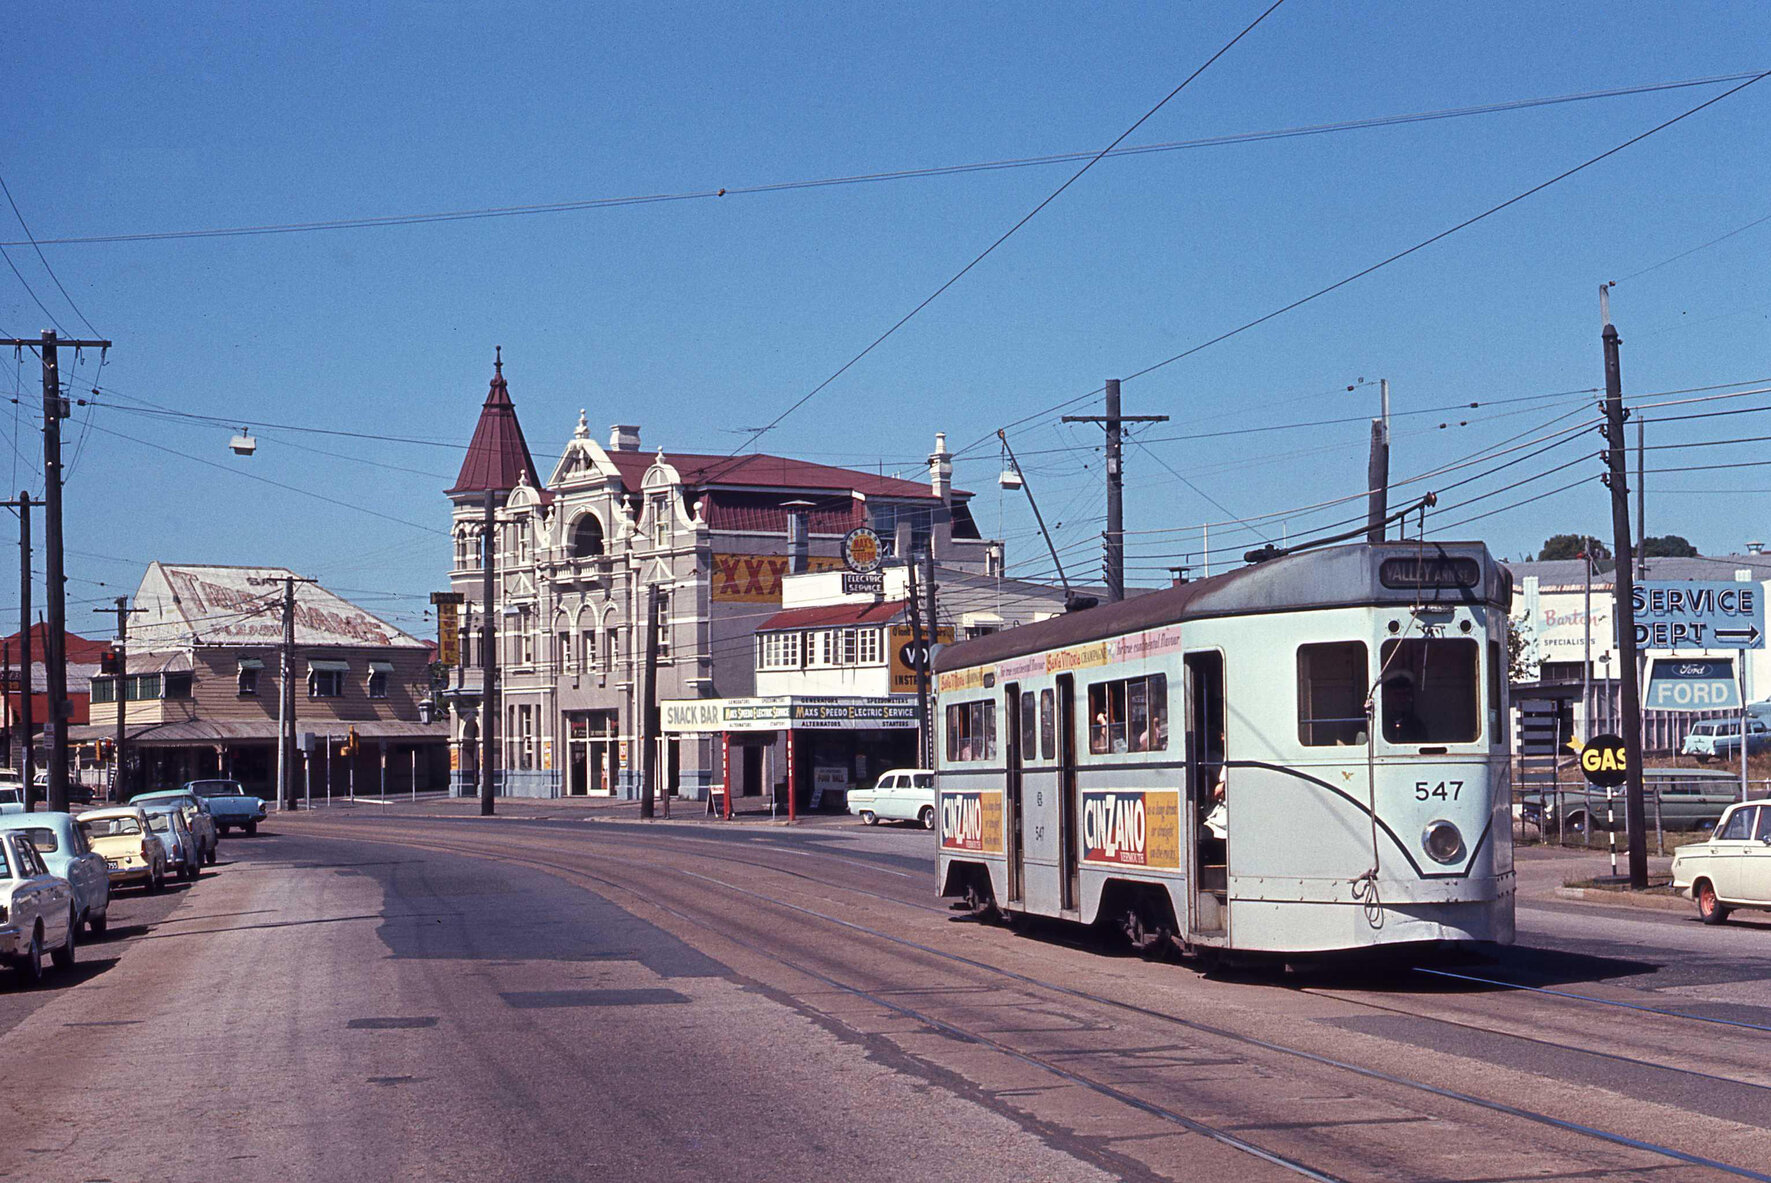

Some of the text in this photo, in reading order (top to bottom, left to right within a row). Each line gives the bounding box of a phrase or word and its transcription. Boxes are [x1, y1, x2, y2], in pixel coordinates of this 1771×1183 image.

[848, 575, 882, 583] ELECTRIC
[1386, 561, 1432, 582] VALLEY
[848, 584, 881, 592] SERVICE
[1633, 584, 1753, 613] SERVICE
[1544, 638, 1596, 646] SPECIALISS
[1634, 622, 1706, 645] DEPT
[1680, 664, 1706, 675] Ford
[1658, 683, 1729, 704] FORD
[667, 705, 719, 724] SNACK BAR
[795, 706, 914, 719] MAXS SPEEDO ELECTRIC SERVICE
[1582, 747, 1627, 772] GAS
[1415, 781, 1464, 801] 547
[942, 795, 982, 844] CINZANO
[1084, 794, 1145, 857] CINZANO
[1120, 852, 1144, 864] VERMOUTH
